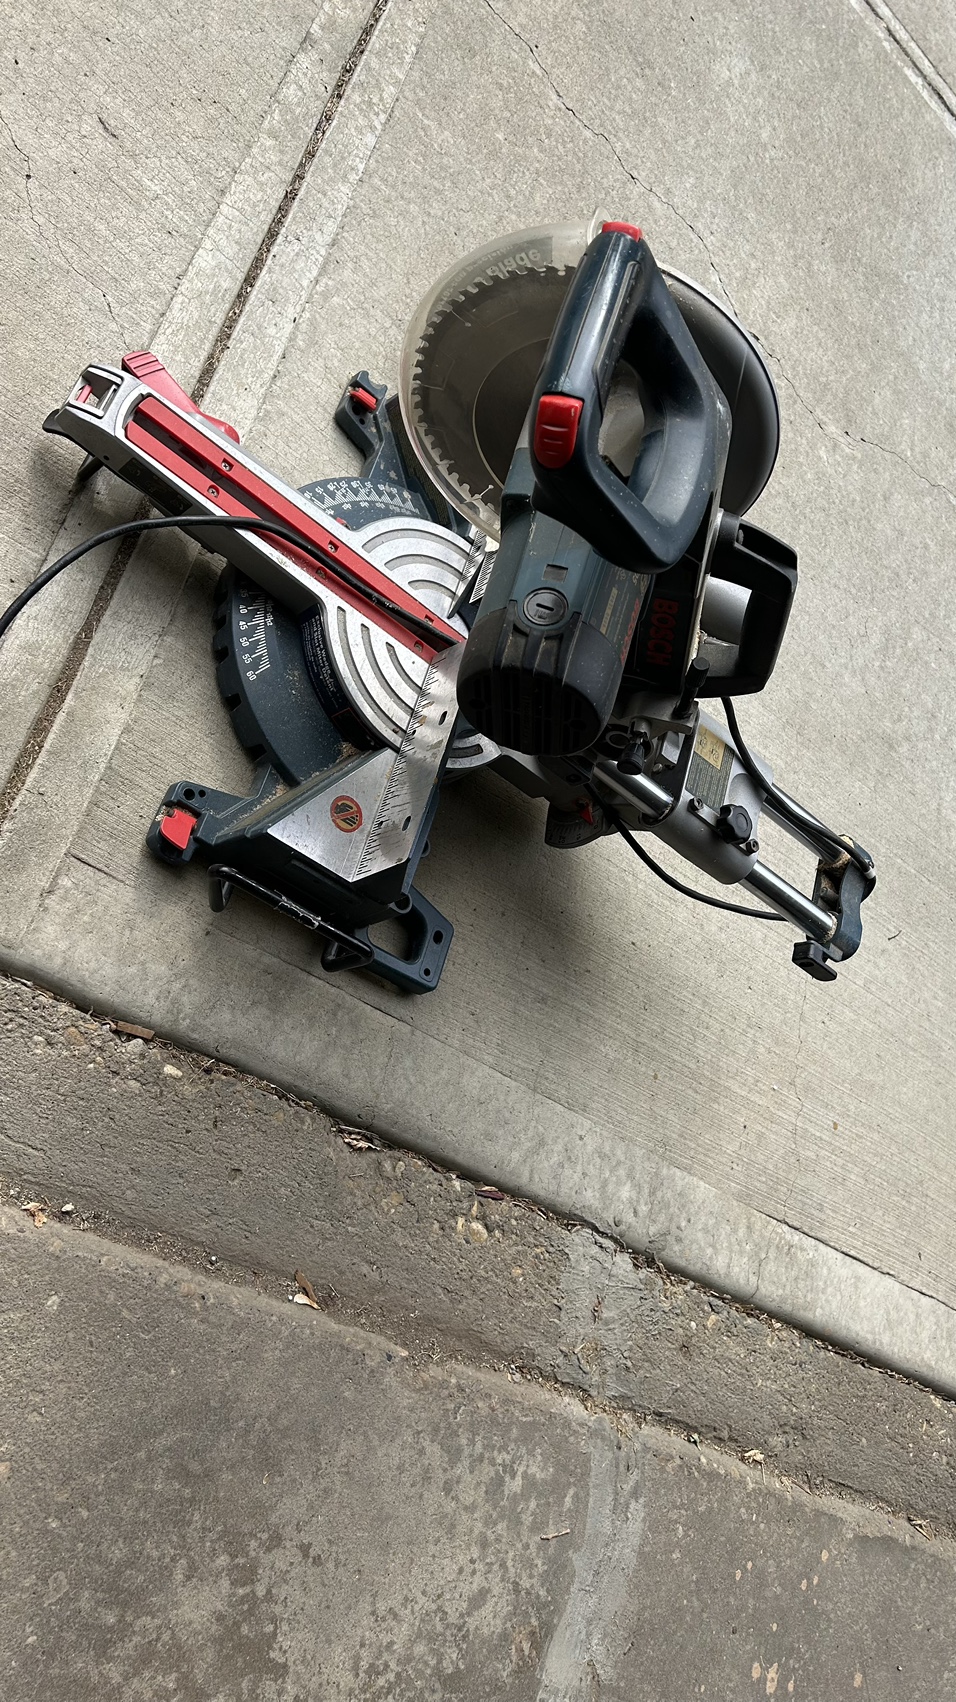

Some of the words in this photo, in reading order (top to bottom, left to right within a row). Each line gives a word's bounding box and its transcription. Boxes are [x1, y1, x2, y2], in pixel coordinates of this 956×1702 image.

[239, 604, 248, 614] 40
[238, 620, 249, 631] 45
[646, 598, 679, 666] BOSCH
[239, 636, 250, 647] 50
[242, 653, 253, 664] 55
[246, 670, 257, 681] 60
